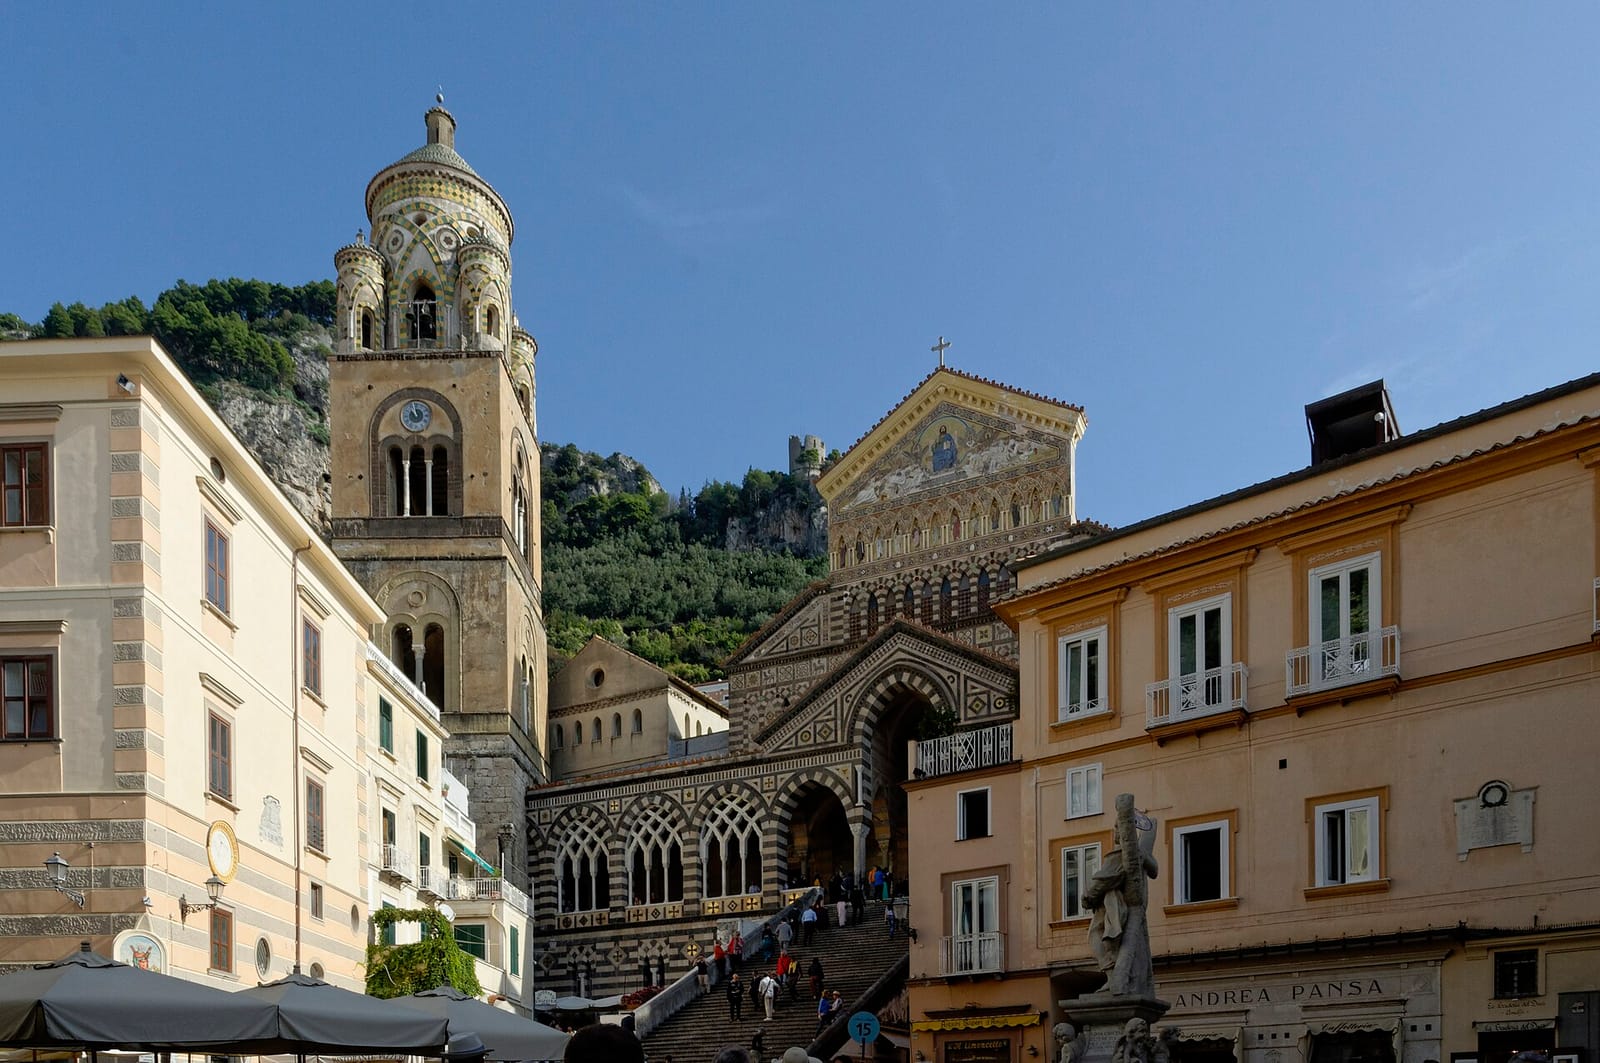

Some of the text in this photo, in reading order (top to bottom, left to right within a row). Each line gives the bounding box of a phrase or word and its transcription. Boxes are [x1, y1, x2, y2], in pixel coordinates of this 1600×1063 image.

[1175, 979, 1382, 1008] ANDREA PANSA
[856, 1023, 871, 1036] 15
